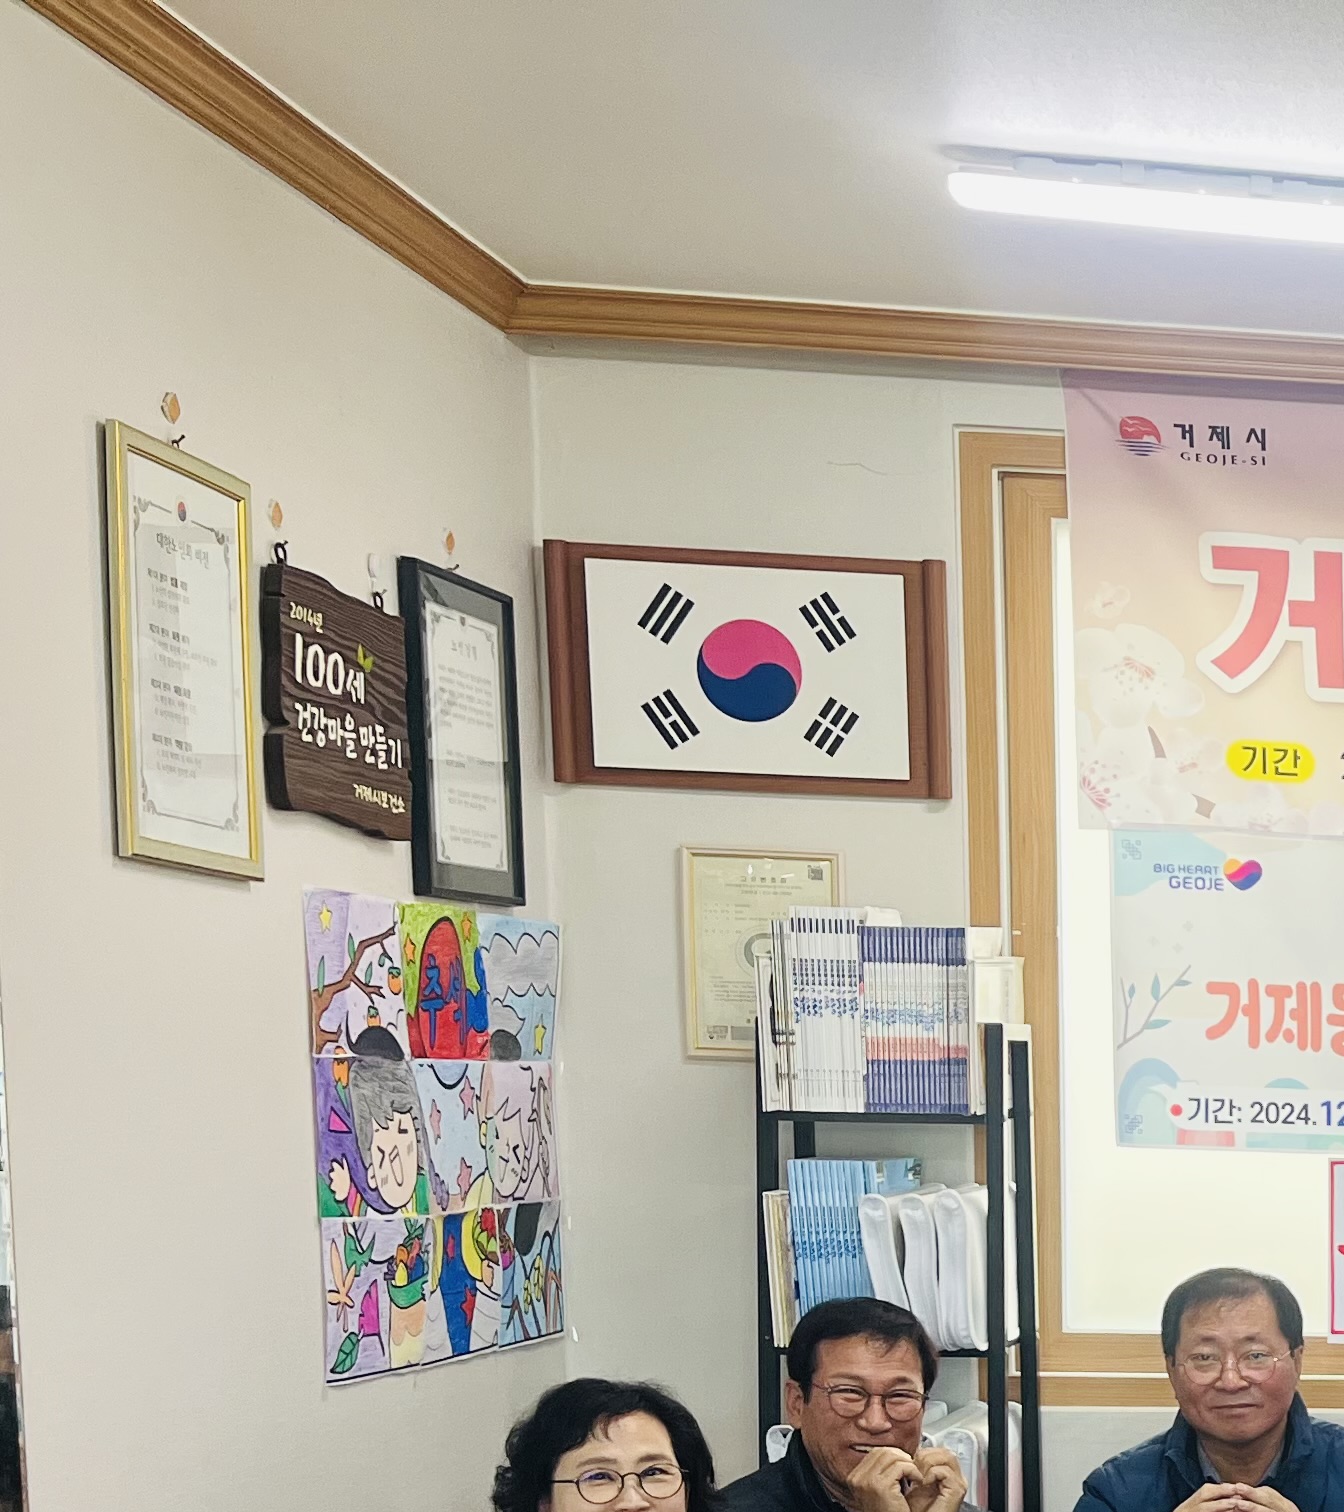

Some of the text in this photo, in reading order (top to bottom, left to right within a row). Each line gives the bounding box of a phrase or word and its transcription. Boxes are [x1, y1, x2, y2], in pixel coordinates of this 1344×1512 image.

[1180, 452, 1267, 467] GEOJE-SI
[289, 602, 324, 634] 2014년
[294, 632, 365, 706] 100세
[294, 701, 403, 769] 건강마을 만들기
[1240, 745, 1300, 778] 기간
[352, 783, 406, 814] 거제시보건소
[1152, 863, 1219, 876] BIG HEART
[1168, 875, 1224, 892] GEOJE
[1187, 1098, 1243, 1126] 기간:
